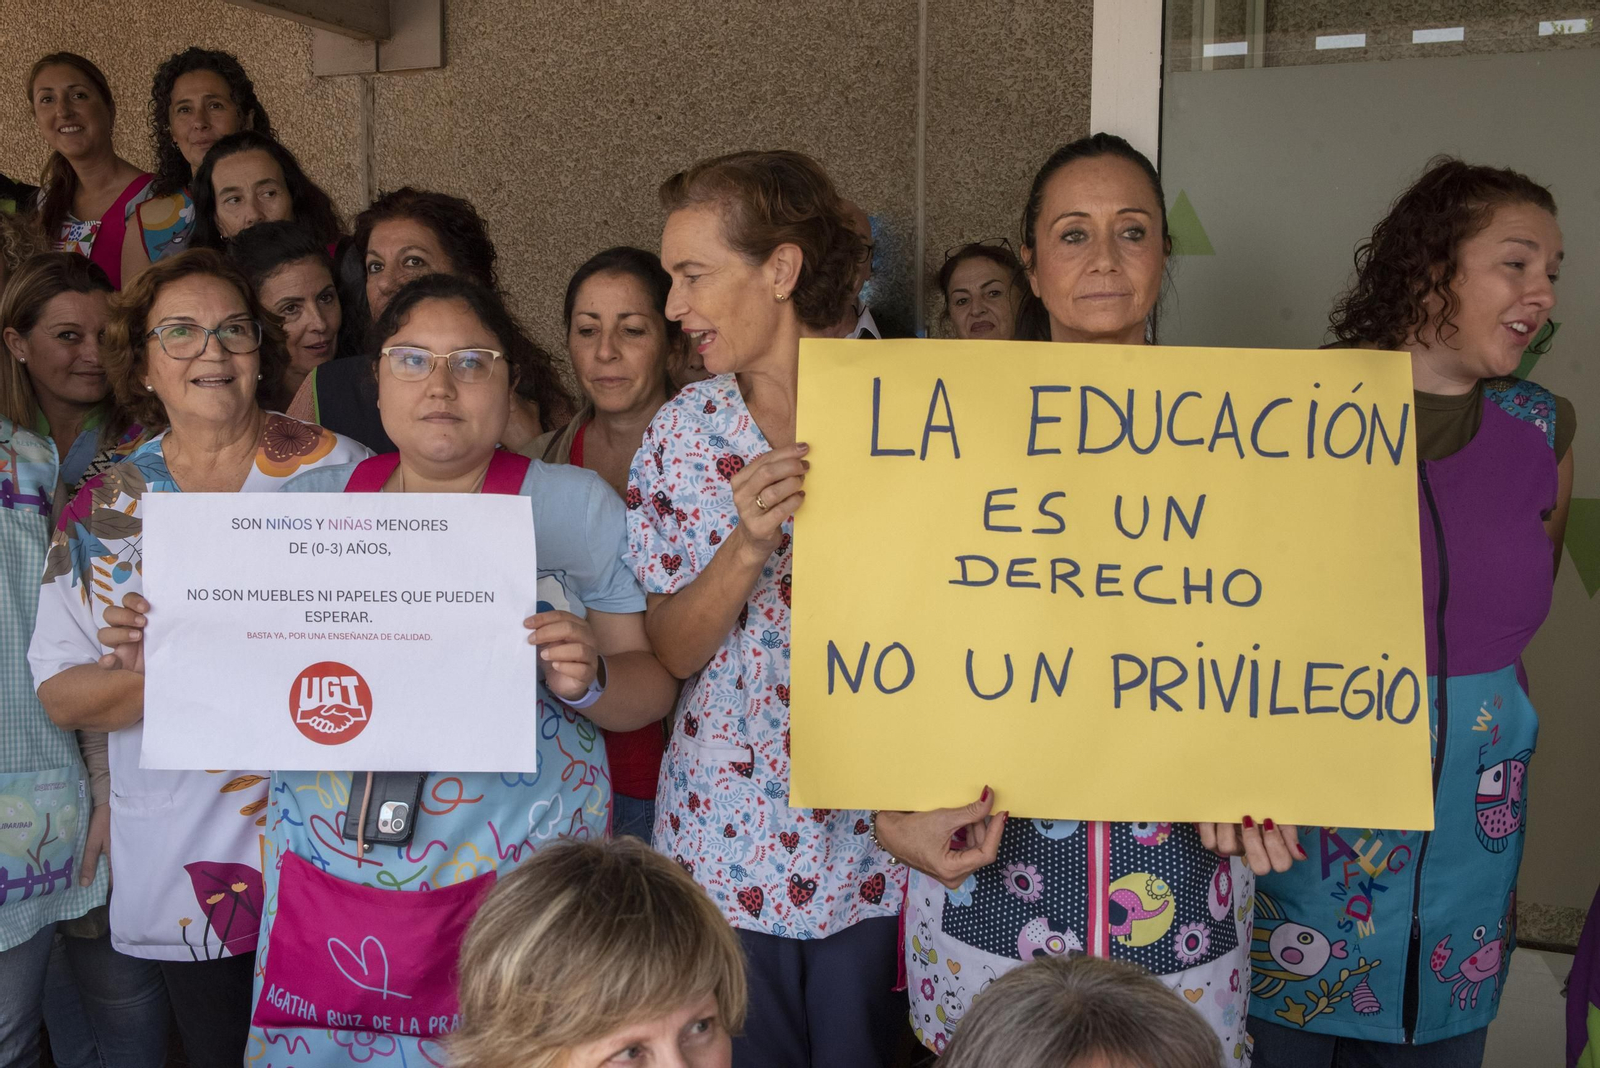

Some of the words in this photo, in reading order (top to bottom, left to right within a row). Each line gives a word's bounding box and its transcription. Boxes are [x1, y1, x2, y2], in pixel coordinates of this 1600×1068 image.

[872, 377, 961, 460] LA
[1028, 381, 1410, 466] EDUCACIÓN
[231, 517, 262, 531] SON
[265, 515, 312, 531] NIÑOS
[316, 518, 325, 531] Y
[328, 516, 373, 531] NIÑAS
[376, 518, 449, 532] MENORES
[985, 489, 1067, 535] ES
[1114, 494, 1207, 541] UN
[289, 541, 309, 555] DE
[311, 542, 343, 558] (0-3)
[346, 539, 392, 557] AÑOS,
[187, 588, 209, 602] NO
[211, 588, 244, 602] SON
[247, 588, 315, 602] MUEBLES
[317, 589, 333, 602] NI
[336, 589, 398, 603] PAPELES
[400, 590, 433, 605] QUE
[435, 590, 495, 604] PUEDEN
[949, 554, 1263, 608] DERECHO
[304, 610, 373, 624] ESPERAR.
[246, 631, 272, 640] BASTA
[273, 631, 288, 641] YA,
[288, 631, 307, 641] POR
[307, 632, 327, 641] UNA
[327, 630, 380, 641] ENSEÑANZA
[380, 632, 393, 641] DE
[393, 632, 433, 642] CALIDAD.
[298, 675, 360, 709] UGT
[828, 640, 916, 695] NO
[965, 648, 1074, 703] UN
[1112, 641, 1421, 725] PRIVILEGIO
[265, 983, 319, 1023] AGATHA
[326, 1009, 363, 1028] RUIZ
[373, 1015, 392, 1032] DE
[400, 1016, 421, 1035] LA
[428, 1013, 466, 1035] PRA
